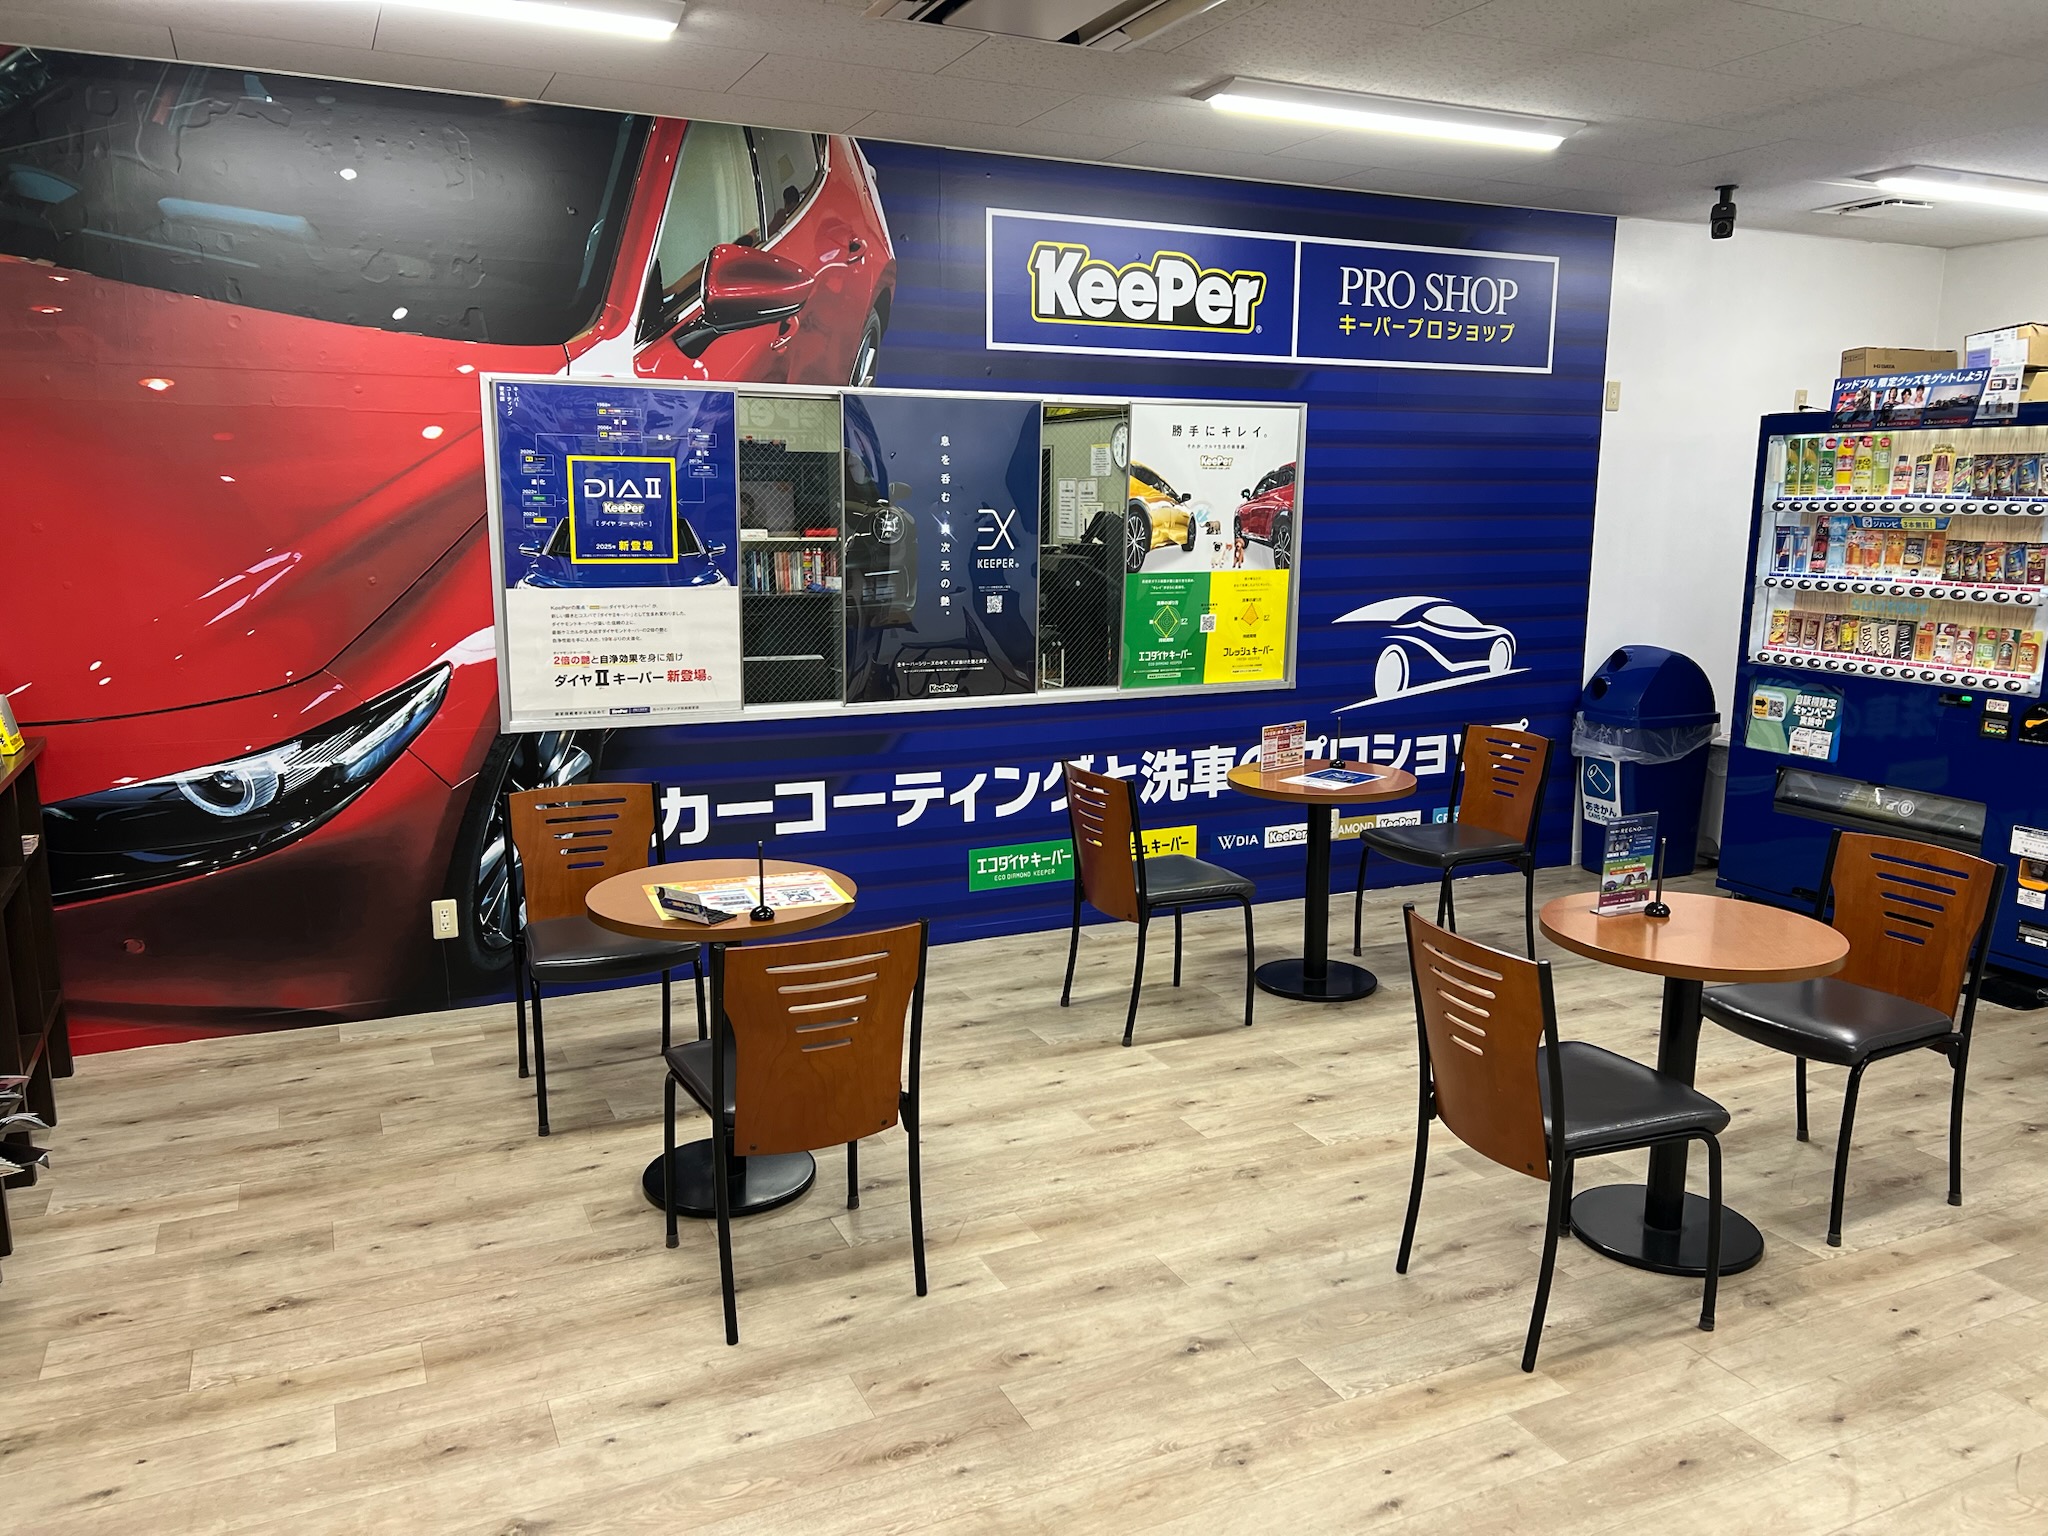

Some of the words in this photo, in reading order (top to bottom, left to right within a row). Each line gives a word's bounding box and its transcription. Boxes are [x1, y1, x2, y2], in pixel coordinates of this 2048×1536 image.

[1033, 247, 1263, 328] KeePer
[1338, 266, 1416, 310] PRO
[1423, 273, 1519, 316] SHOP
[1338, 313, 1516, 344] キーパープロショップ
[1835, 377, 1876, 391] レッドブル
[1171, 424, 1268, 439] 勝手にキレイ。
[1200, 455, 1234, 467] KeePer
[584, 478, 643, 499] DIA
[603, 501, 646, 514] KeePer
[976, 508, 1016, 551] EX
[595, 543, 616, 551] 2025年
[618, 540, 654, 552] 新登場
[976, 558, 1015, 569] KEEPER
[1862, 626, 1873, 653] BOSS
[1880, 628, 1891, 655] BOSS
[1138, 649, 1192, 662] エコダイヤキーパー
[1223, 645, 1275, 657] フレッシュキーパー
[553, 652, 684, 666] 2倍の艶と自浄効果を身に着け
[929, 683, 959, 693] KeePer
[1795, 694, 1839, 710] 自販機限定
[1793, 705, 1836, 720] キャンペーン
[1585, 801, 1618, 818] あきかん
[1268, 828, 1308, 844] KeePer
[1338, 821, 1375, 836] AMOND
[976, 848, 1072, 875] エコダイヤキーパー
[993, 874, 1006, 882] ECO
[1006, 871, 1031, 880] DIAMOND
[1033, 868, 1056, 877] KEEPER
